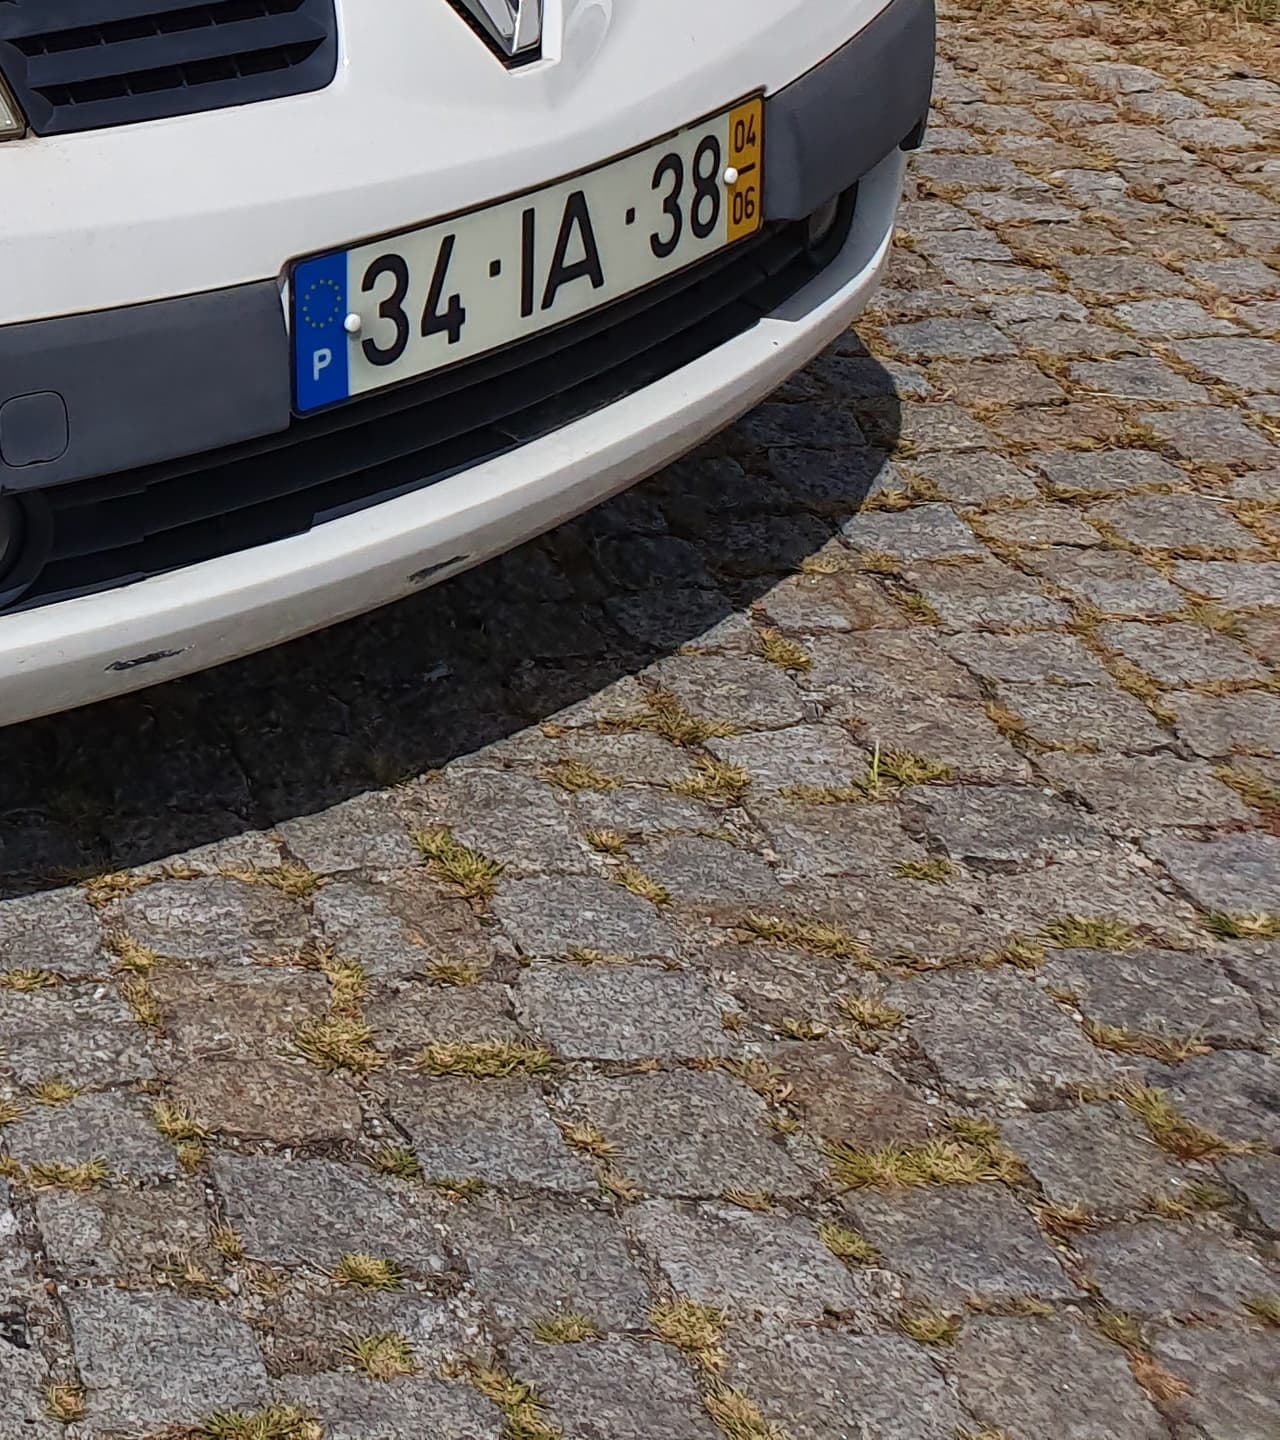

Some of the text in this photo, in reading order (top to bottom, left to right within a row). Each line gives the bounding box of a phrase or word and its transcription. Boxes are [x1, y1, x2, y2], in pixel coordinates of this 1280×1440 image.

[734, 113, 756, 154] 04
[732, 186, 756, 226] 06
[313, 348, 333, 382] P
